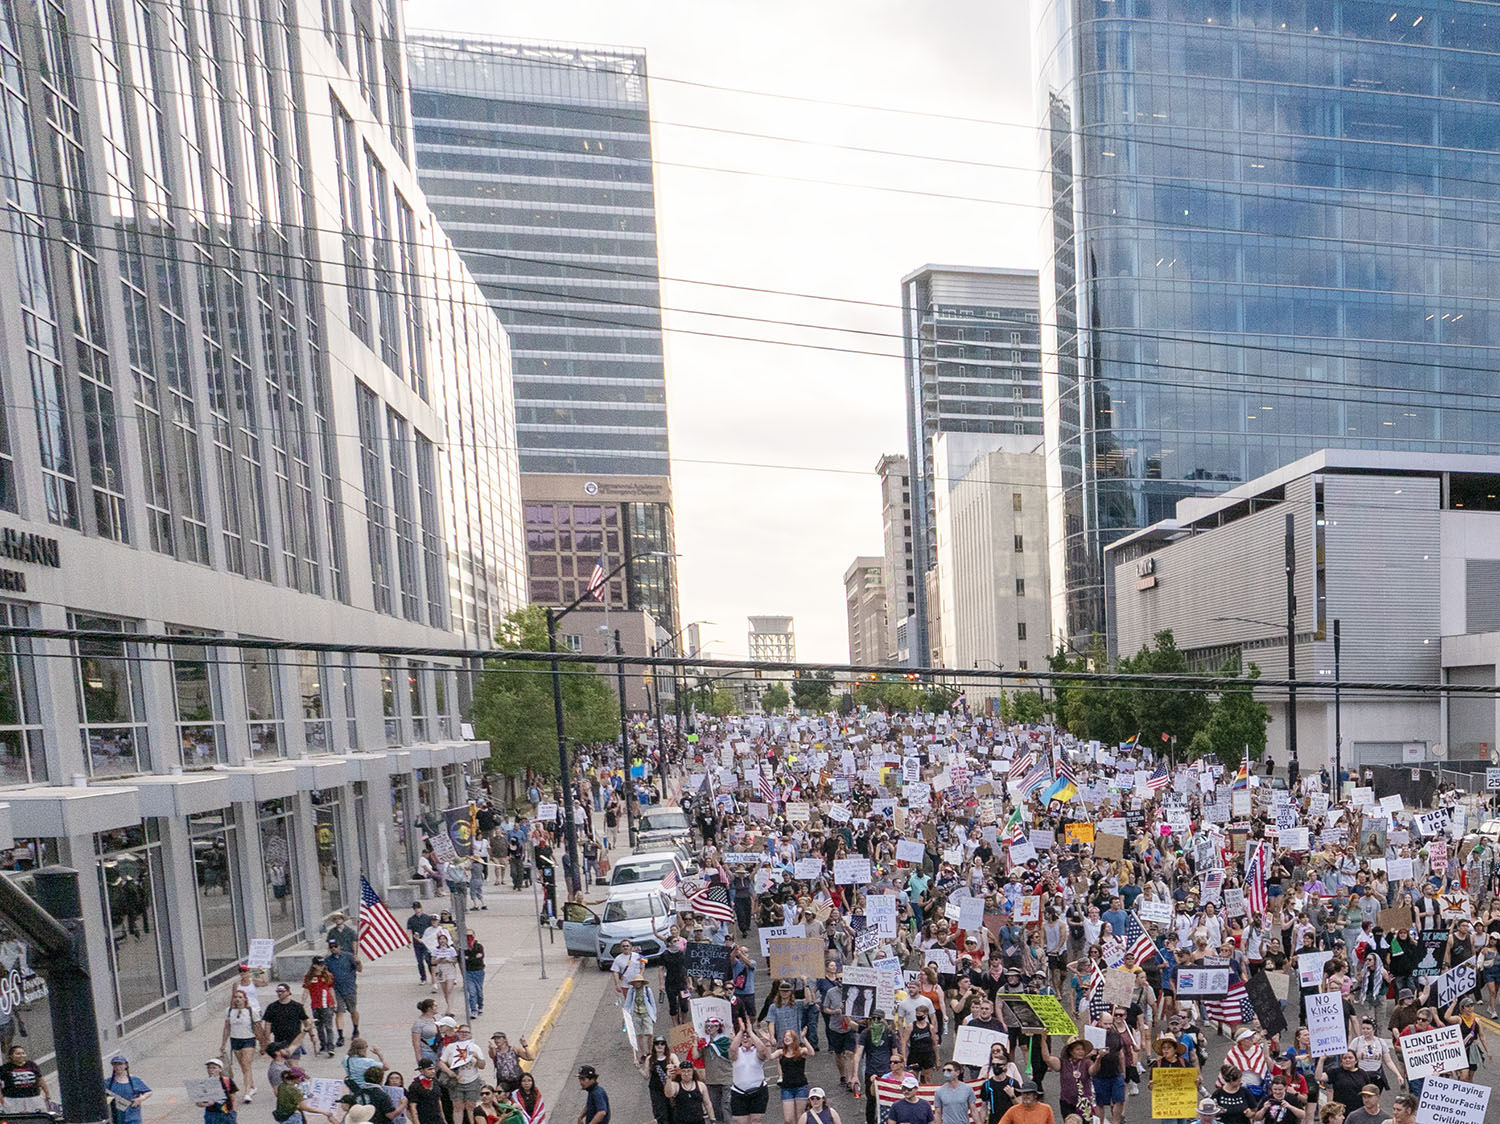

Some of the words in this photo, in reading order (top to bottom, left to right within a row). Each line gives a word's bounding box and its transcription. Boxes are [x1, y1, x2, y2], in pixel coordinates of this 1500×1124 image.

[1488, 779, 1500, 787] 25
[1420, 806, 1455, 824] FUCK
[1430, 820, 1447, 831] ICE
[771, 928, 788, 937] DUE
[1446, 962, 1467, 987] NO
[1438, 972, 1476, 1006] KINGS
[1315, 996, 1330, 1006] NO
[1311, 1005, 1339, 1016] KINGS
[1405, 1035, 1434, 1049] LONG
[1435, 1029, 1458, 1042] LIVE
[1427, 1044, 1439, 1052] THE
[1409, 1047, 1462, 1068] CONSTITUTION
[1428, 1078, 1449, 1092] Stop
[1452, 1083, 1485, 1099] Playing
[1420, 1101, 1454, 1115] Dreams
[1456, 1108, 1467, 1117] on
[1422, 1091, 1439, 1102] Out
[1439, 1094, 1460, 1107] Your
[1459, 1098, 1485, 1112] Facist
